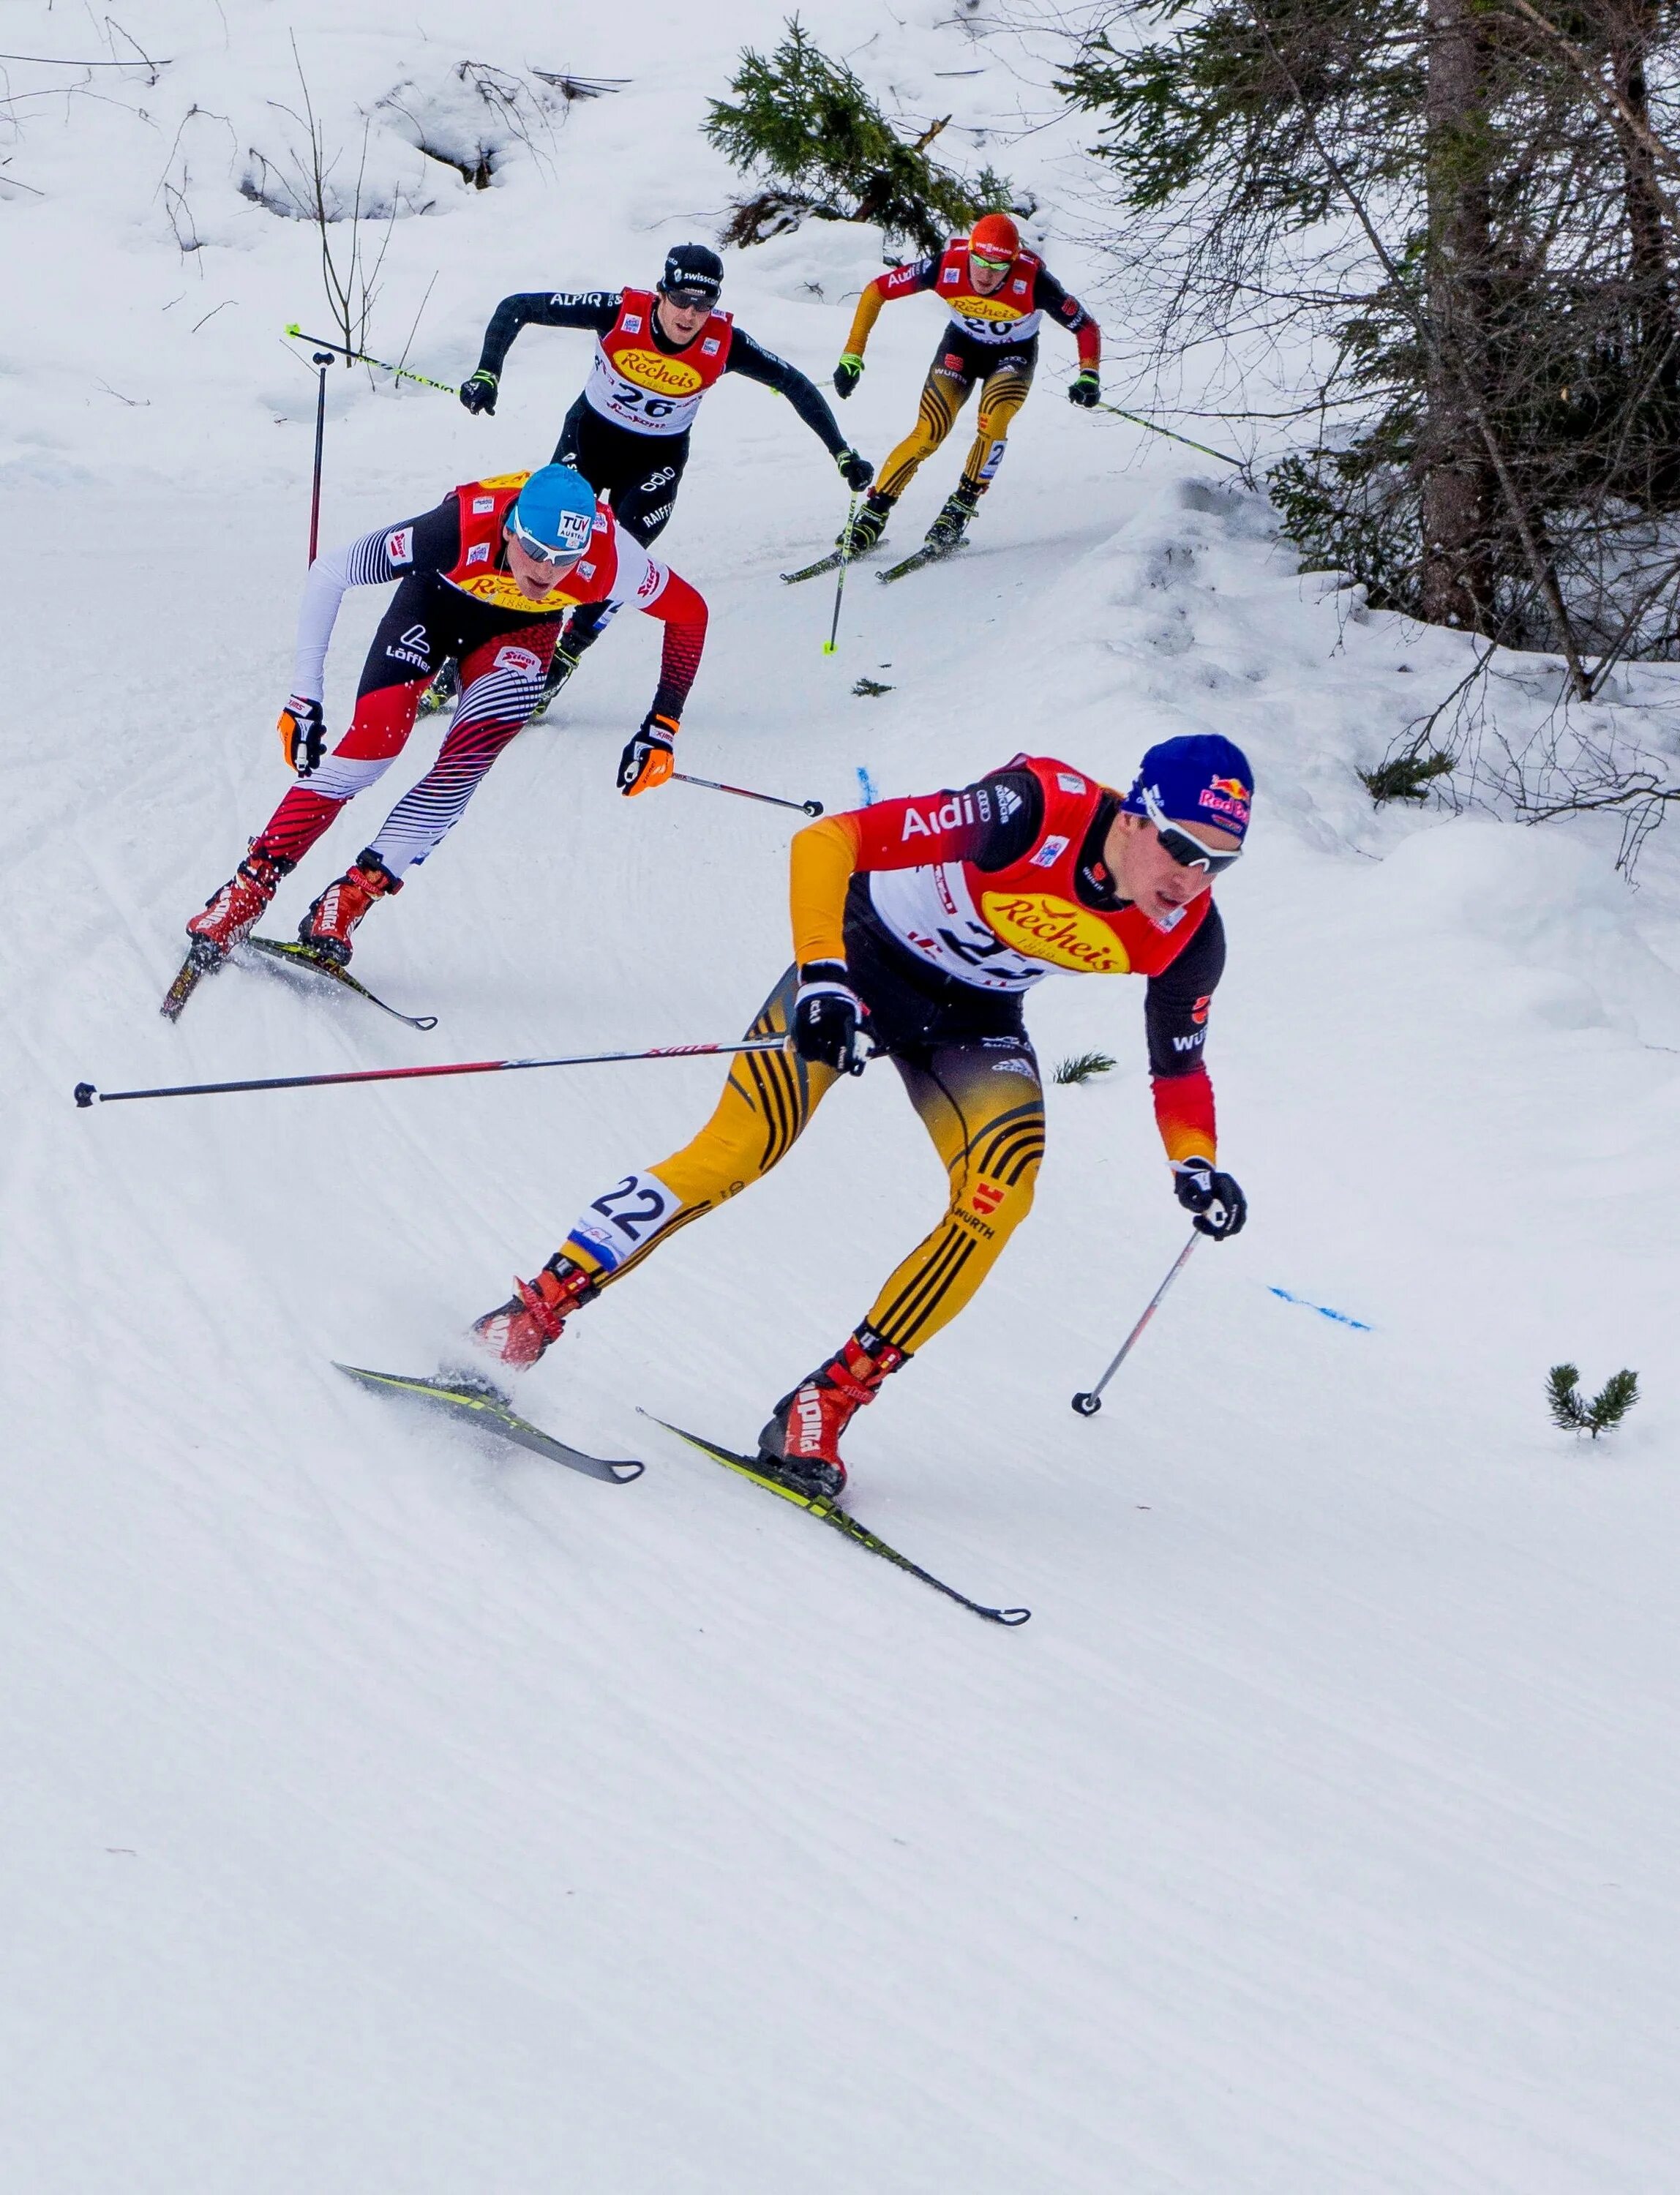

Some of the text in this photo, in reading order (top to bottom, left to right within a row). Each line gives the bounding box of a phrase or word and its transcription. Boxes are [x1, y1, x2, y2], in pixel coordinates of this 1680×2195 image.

[888, 265, 916, 288] Audi
[550, 293, 602, 307] ALPIQ
[964, 315, 1013, 336] 20
[621, 352, 696, 389] Recheis
[612, 383, 676, 418] 26
[640, 467, 675, 492] odlo
[386, 645, 430, 672] Löffler
[1198, 789, 1234, 814] Red
[993, 899, 1118, 971] Recheis
[590, 1176, 664, 1242] 22
